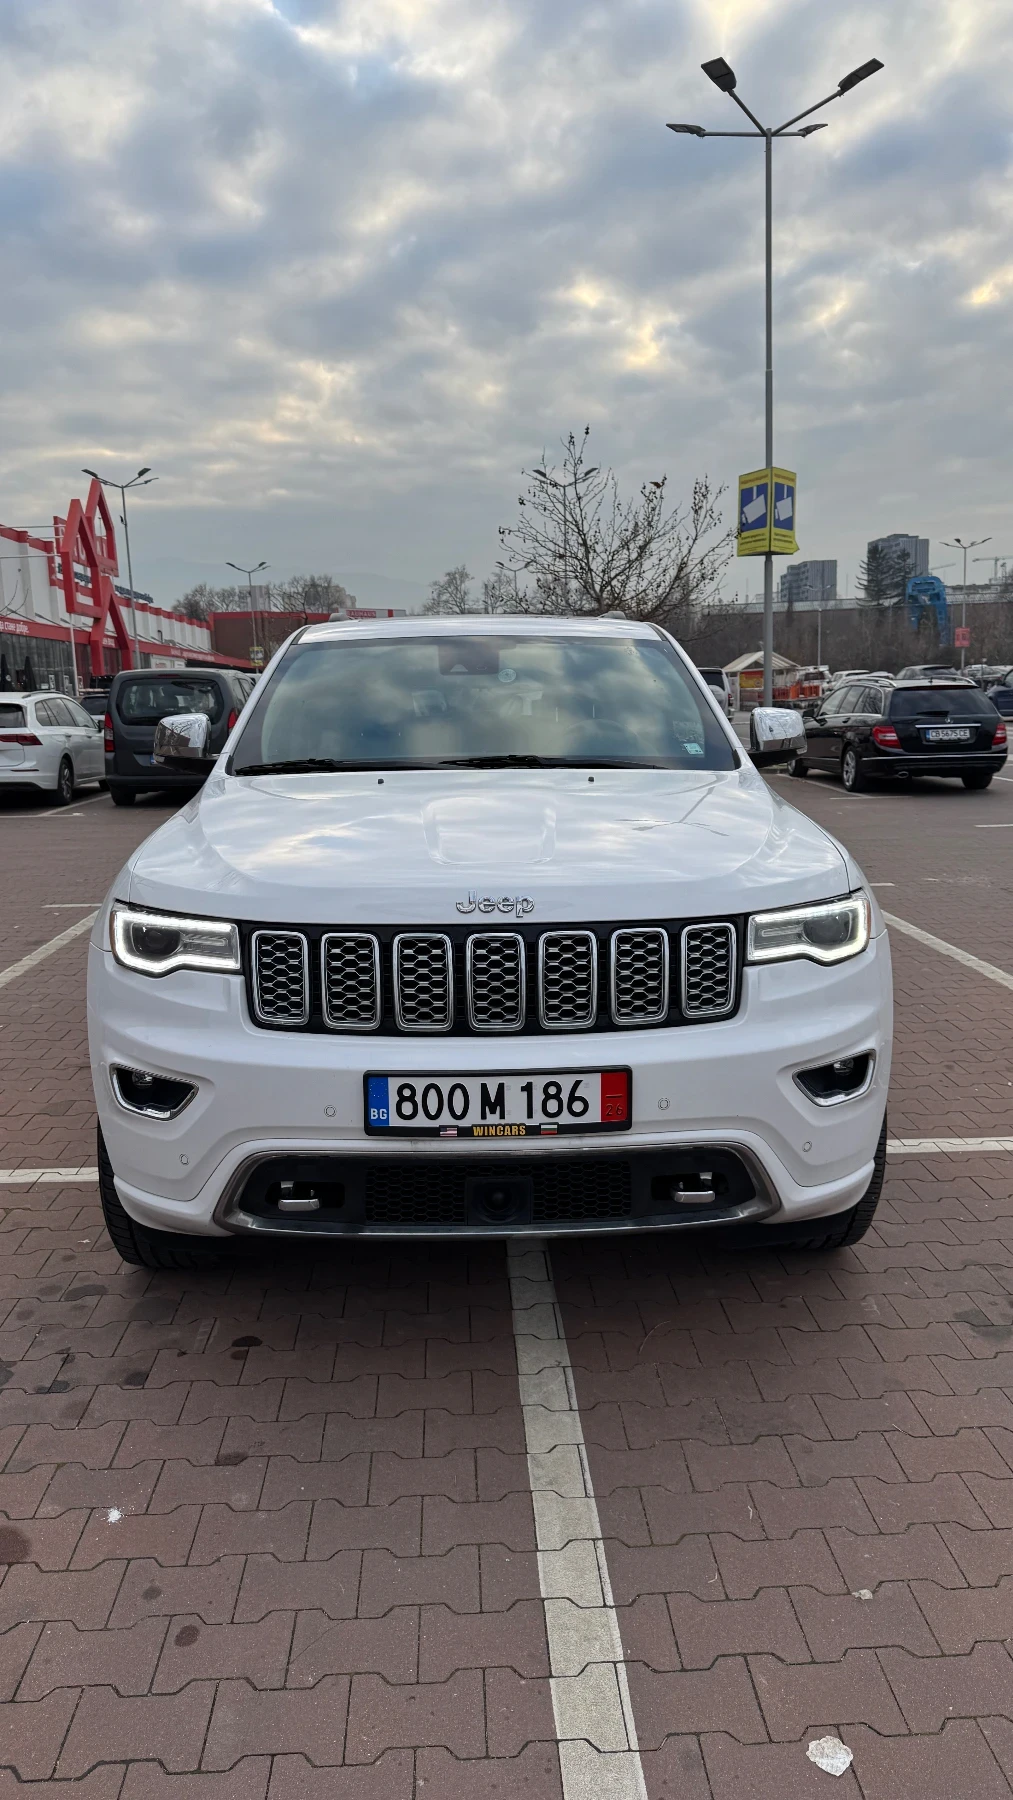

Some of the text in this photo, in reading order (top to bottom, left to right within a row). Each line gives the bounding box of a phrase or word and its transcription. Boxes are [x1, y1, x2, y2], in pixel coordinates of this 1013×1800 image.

[455, 889, 535, 918] Jeep
[395, 1079, 590, 1121] 800 M 186
[370, 1107, 388, 1120] BG
[603, 1102, 623, 1116] 26
[472, 1125, 526, 1137] WINCARS
